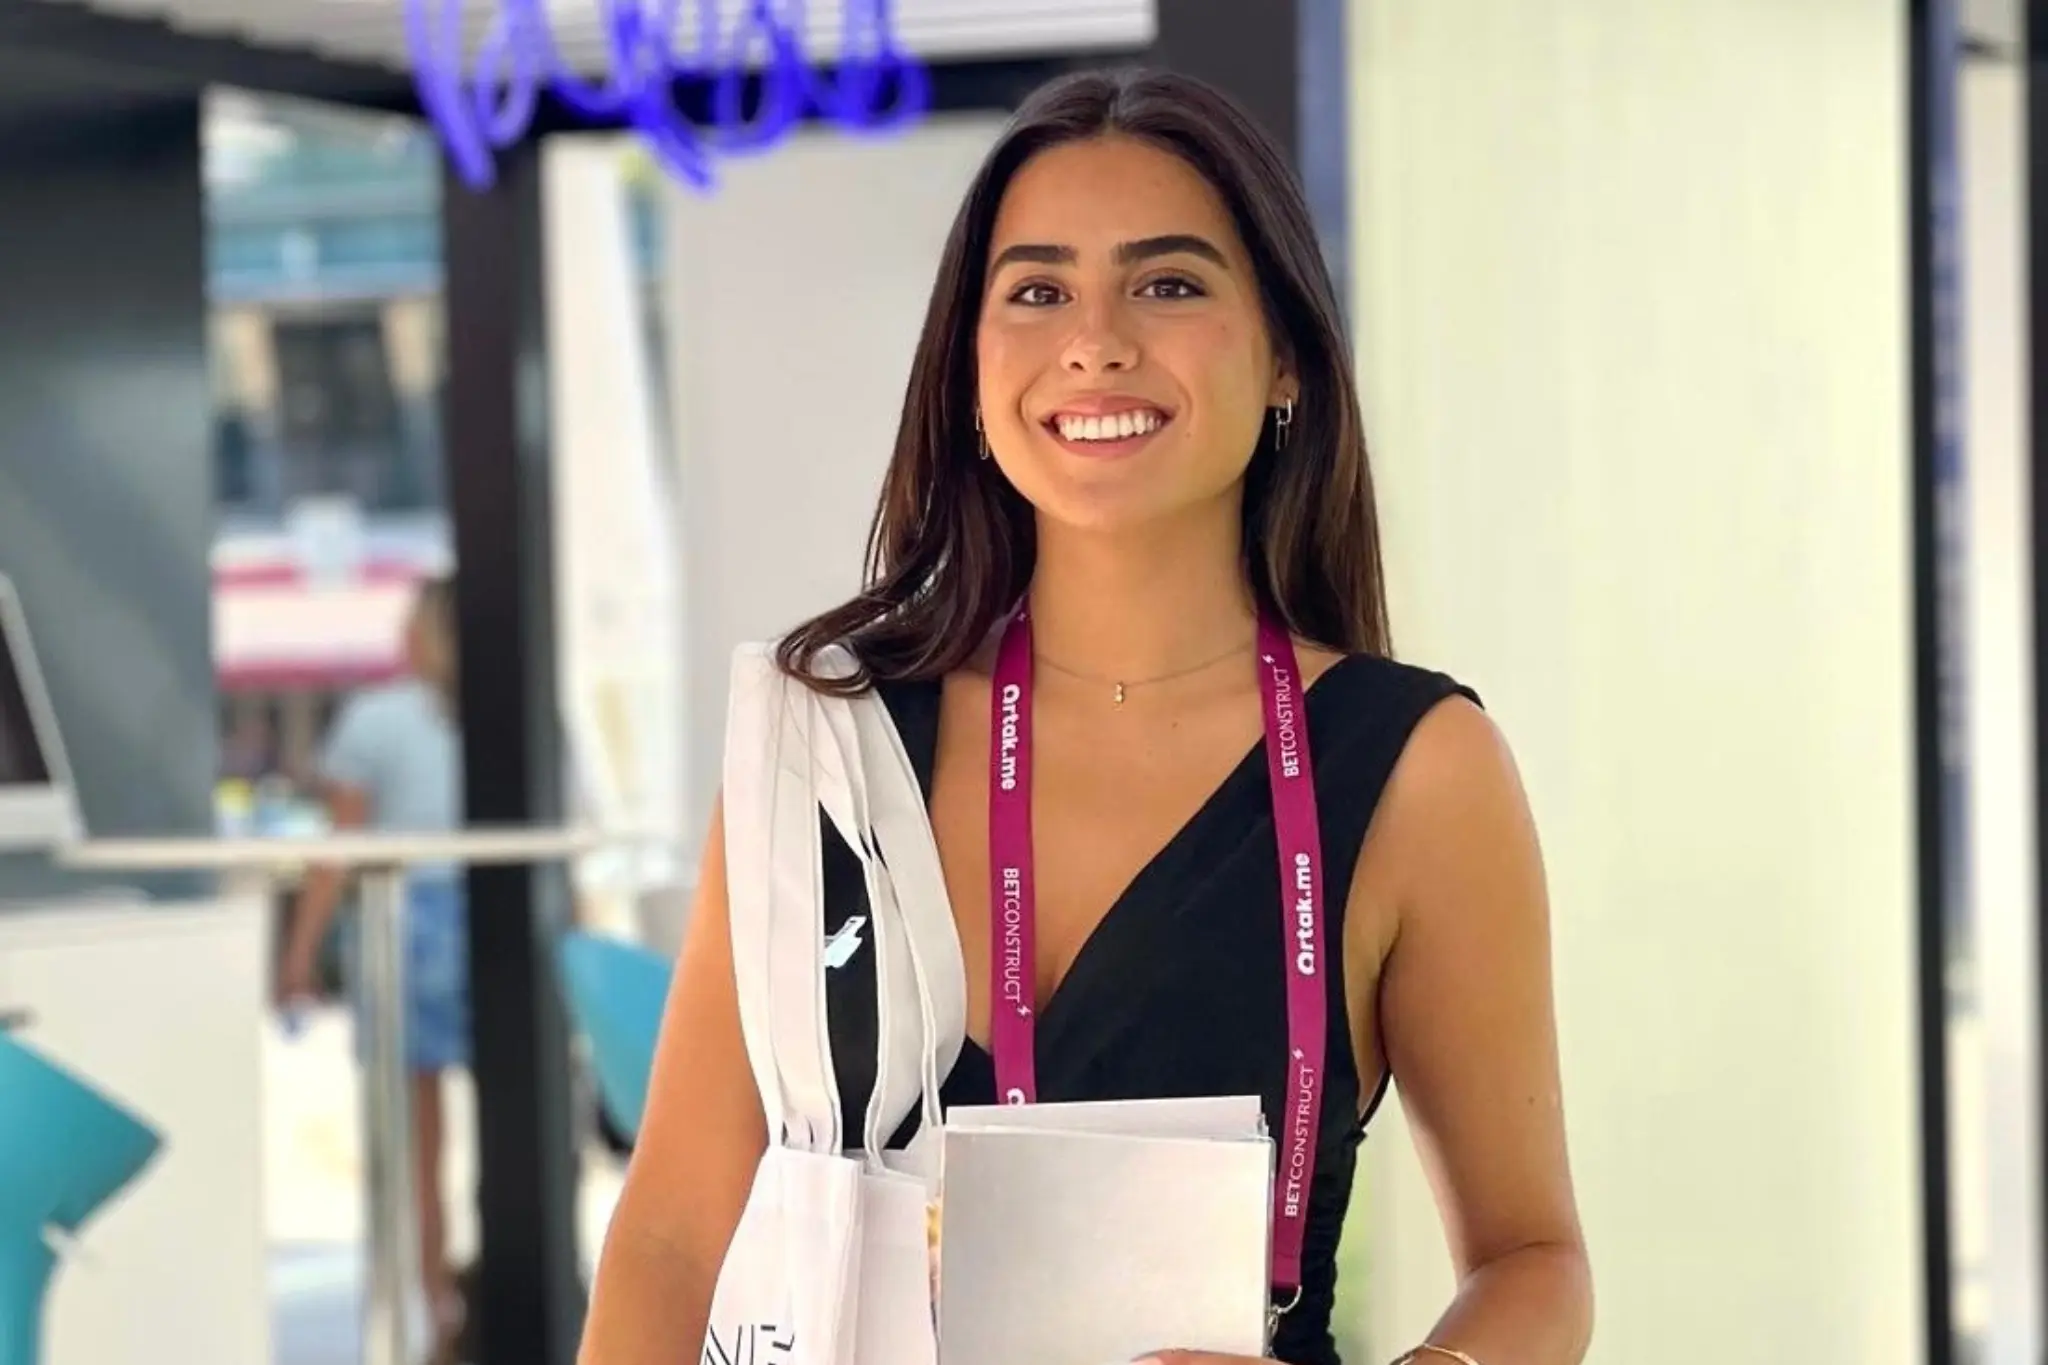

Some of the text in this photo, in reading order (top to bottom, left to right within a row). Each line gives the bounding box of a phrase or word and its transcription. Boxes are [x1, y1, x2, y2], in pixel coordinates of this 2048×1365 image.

[1273, 666, 1300, 777] BETCONSTRUCT
[1003, 867, 1021, 1003] BETCONSTRUCT
[1284, 1065, 1315, 1217] BETCONSTRUCT
